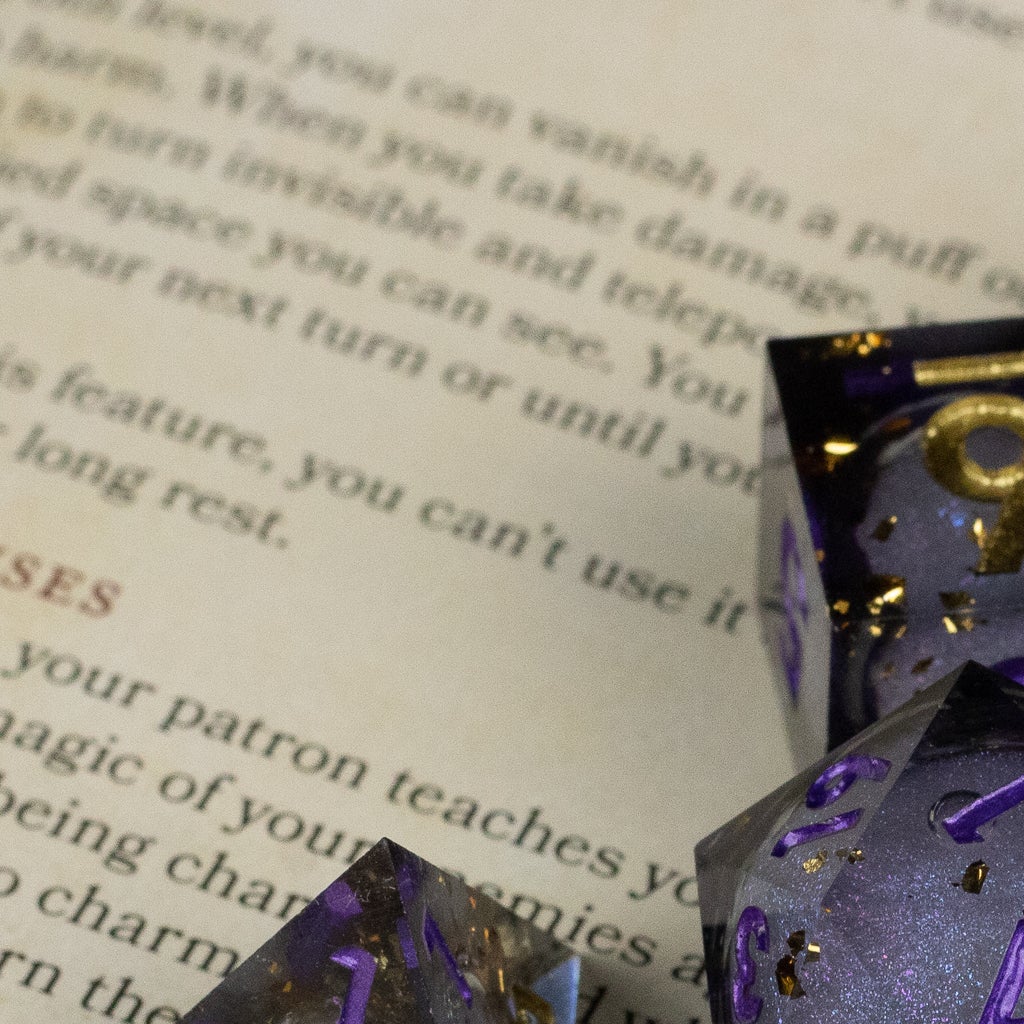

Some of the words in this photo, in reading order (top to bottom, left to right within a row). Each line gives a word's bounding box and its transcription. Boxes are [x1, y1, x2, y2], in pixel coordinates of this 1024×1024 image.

[471, 230, 598, 293] and
[299, 305, 431, 378] turn
[439, 358, 516, 404] or
[520, 386, 668, 460] until
[643, 341, 750, 420] You
[12, 420, 156, 508] long
[158, 477, 290, 552] rest.
[48, 360, 275, 476] feature,
[283, 448, 408, 516] you
[417, 496, 571, 572] can't
[579, 552, 694, 616] use
[702, 584, 750, 637] it
[0, 639, 158, 710] your
[155, 693, 370, 793] patron
[385, 766, 628, 880] teaches
[158, 771, 237, 813] of
[37, 883, 241, 980] charm
